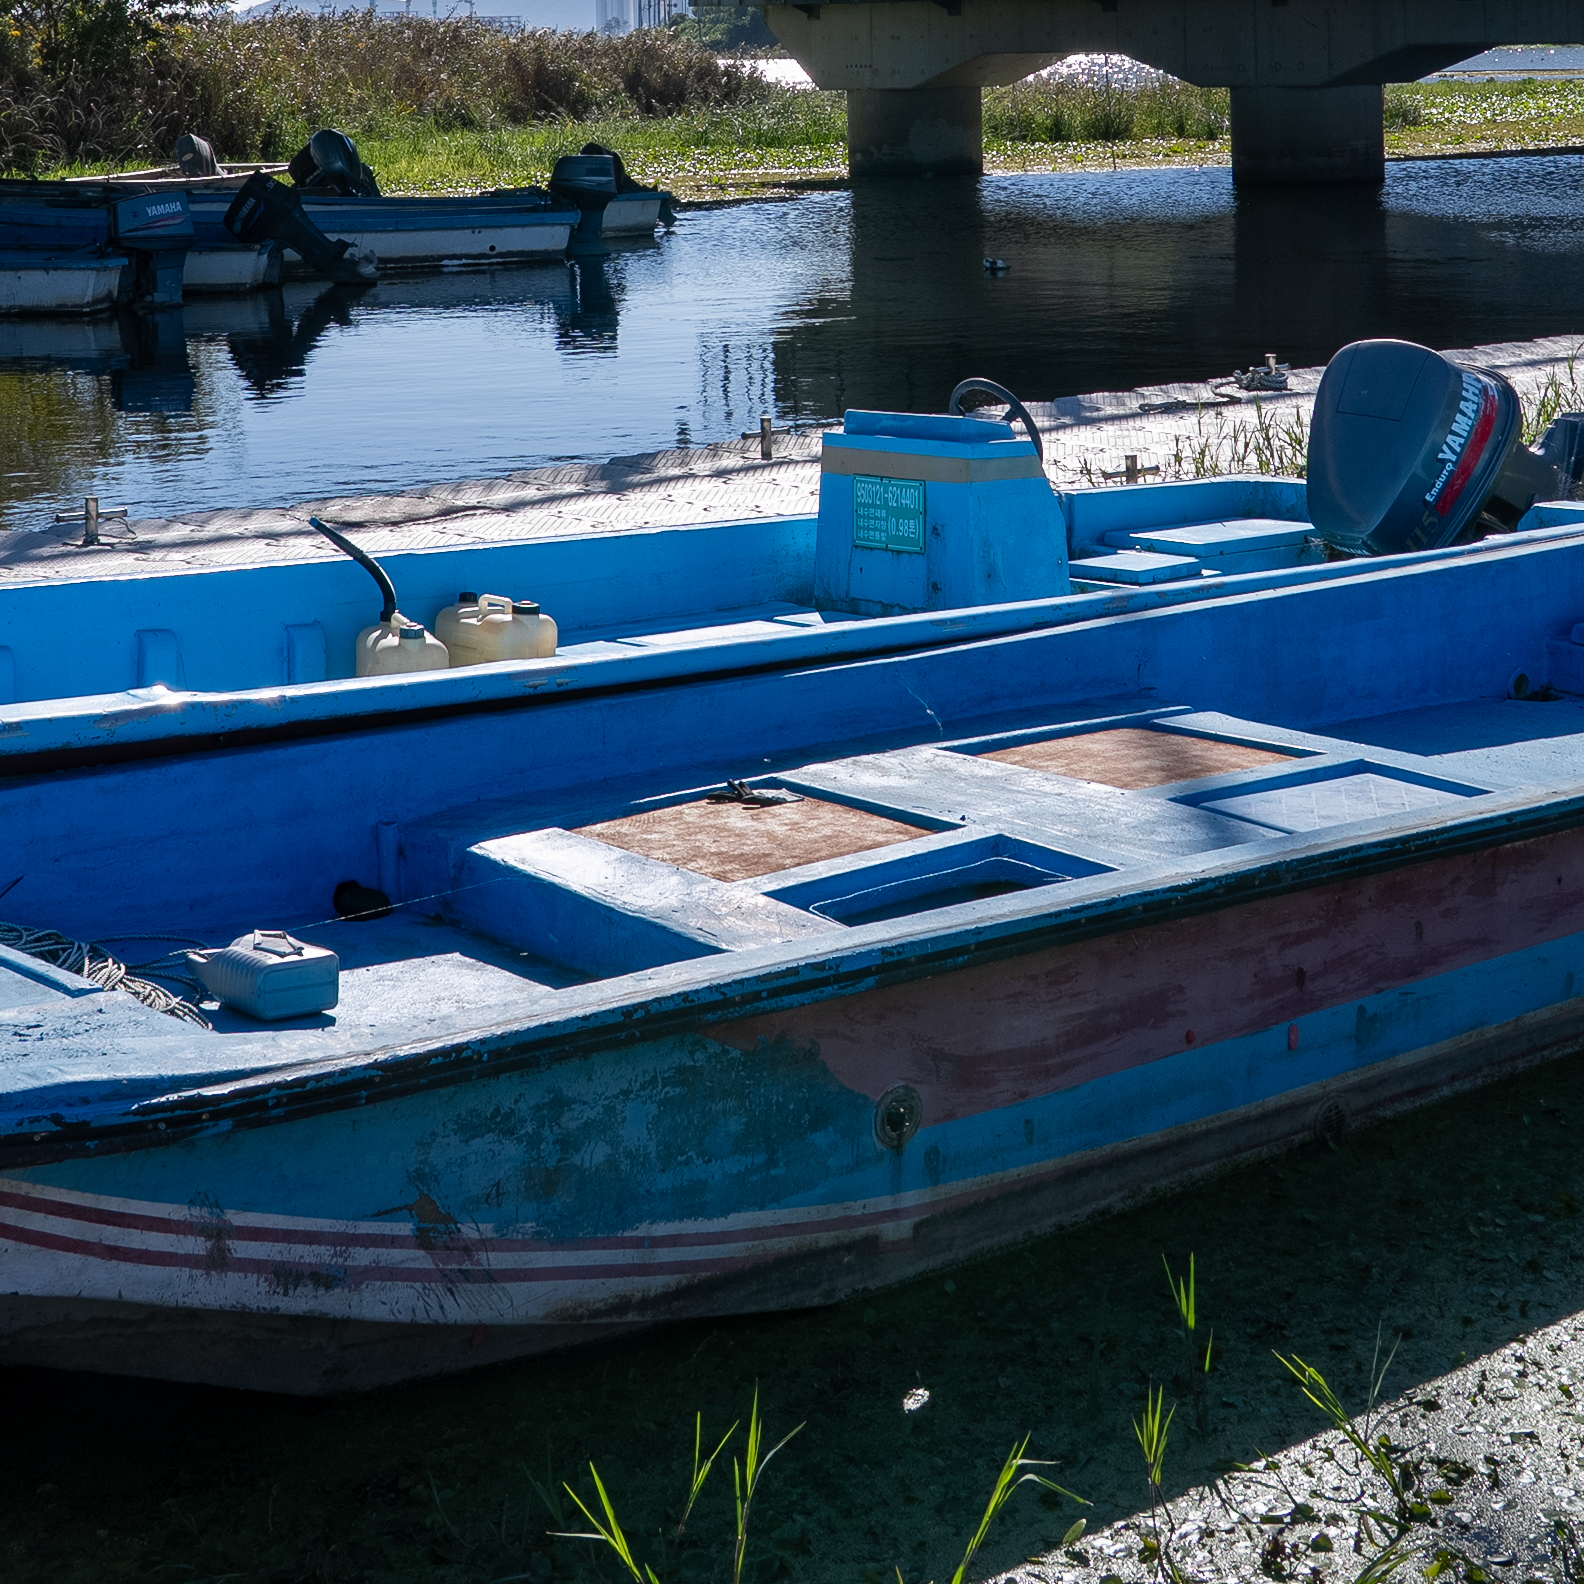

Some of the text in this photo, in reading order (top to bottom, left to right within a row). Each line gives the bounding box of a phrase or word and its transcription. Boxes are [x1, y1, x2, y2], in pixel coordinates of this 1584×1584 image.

[145, 201, 183, 217] YAMAHA
[239, 196, 257, 219] YAMAHA
[1437, 372, 1483, 462] YAMAHA
[1424, 461, 1453, 503] Enduro
[888, 516, 919, 539] (0.98톤)
